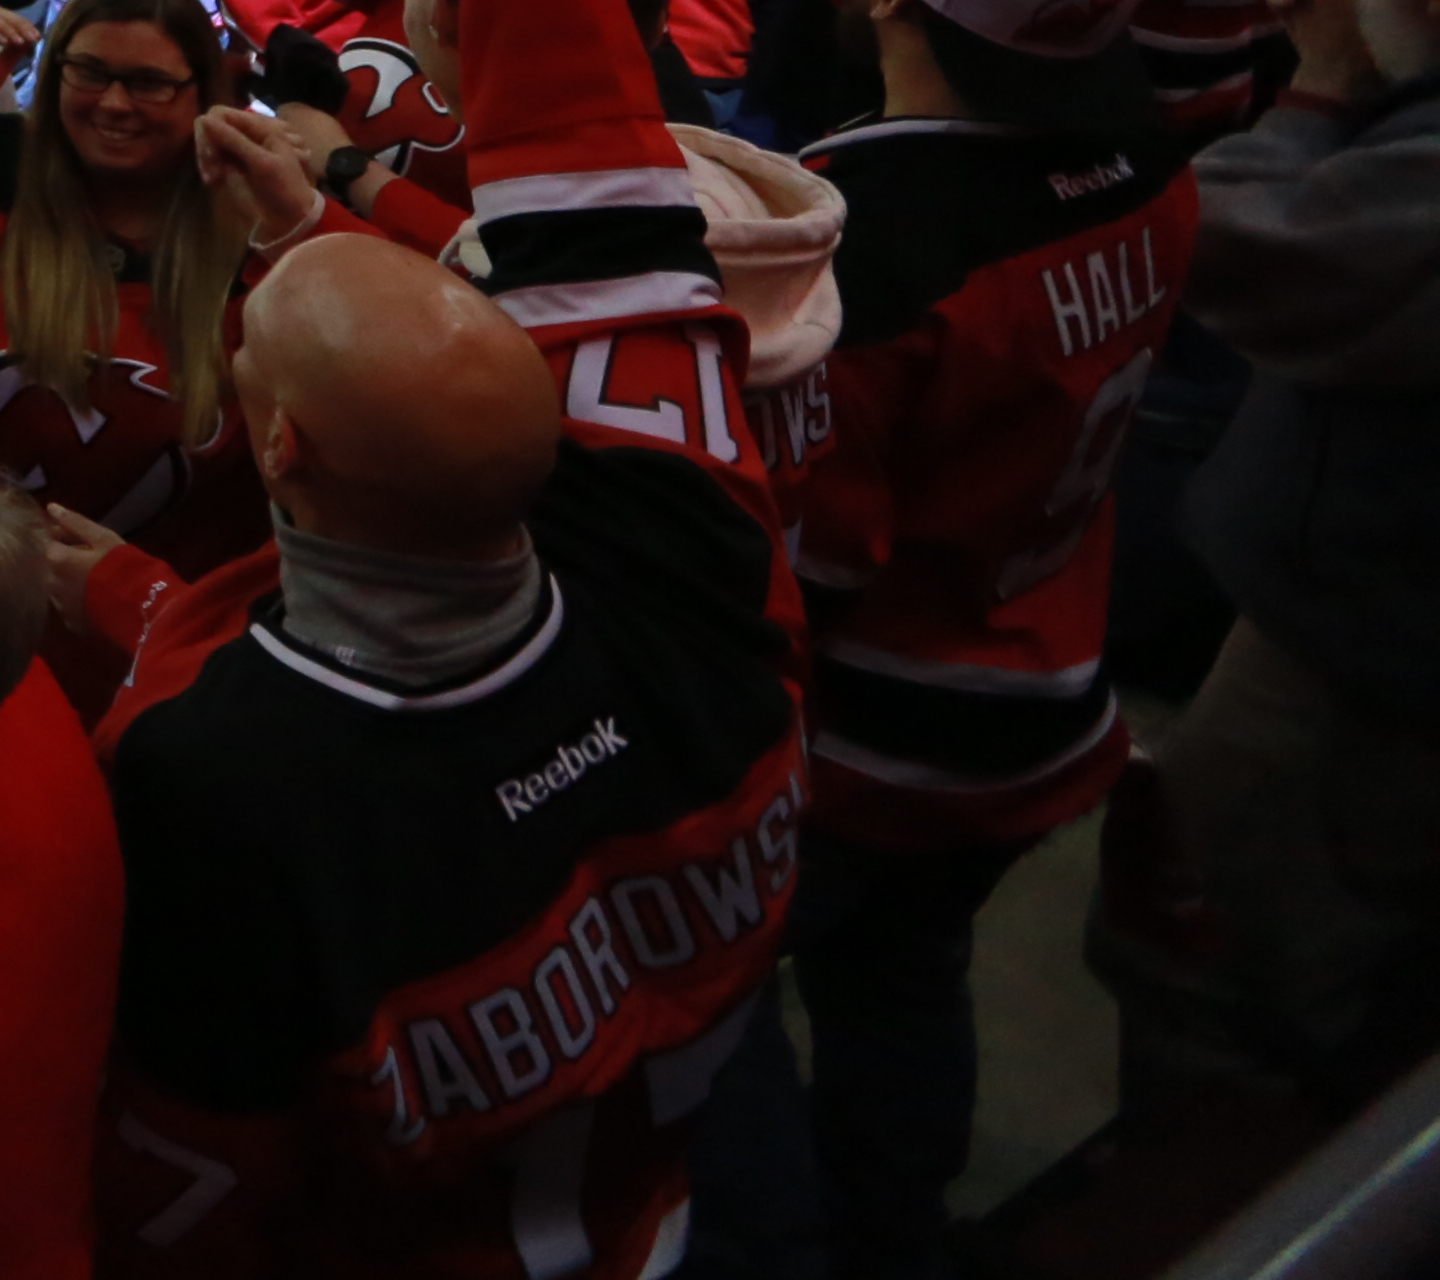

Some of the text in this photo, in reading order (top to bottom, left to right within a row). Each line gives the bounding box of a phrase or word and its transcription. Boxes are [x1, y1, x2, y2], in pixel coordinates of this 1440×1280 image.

[1047, 152, 1133, 202] Reebok
[1040, 226, 1167, 358] HALL
[496, 716, 629, 824] Reebok
[370, 783, 811, 1148] ZABOROWS
